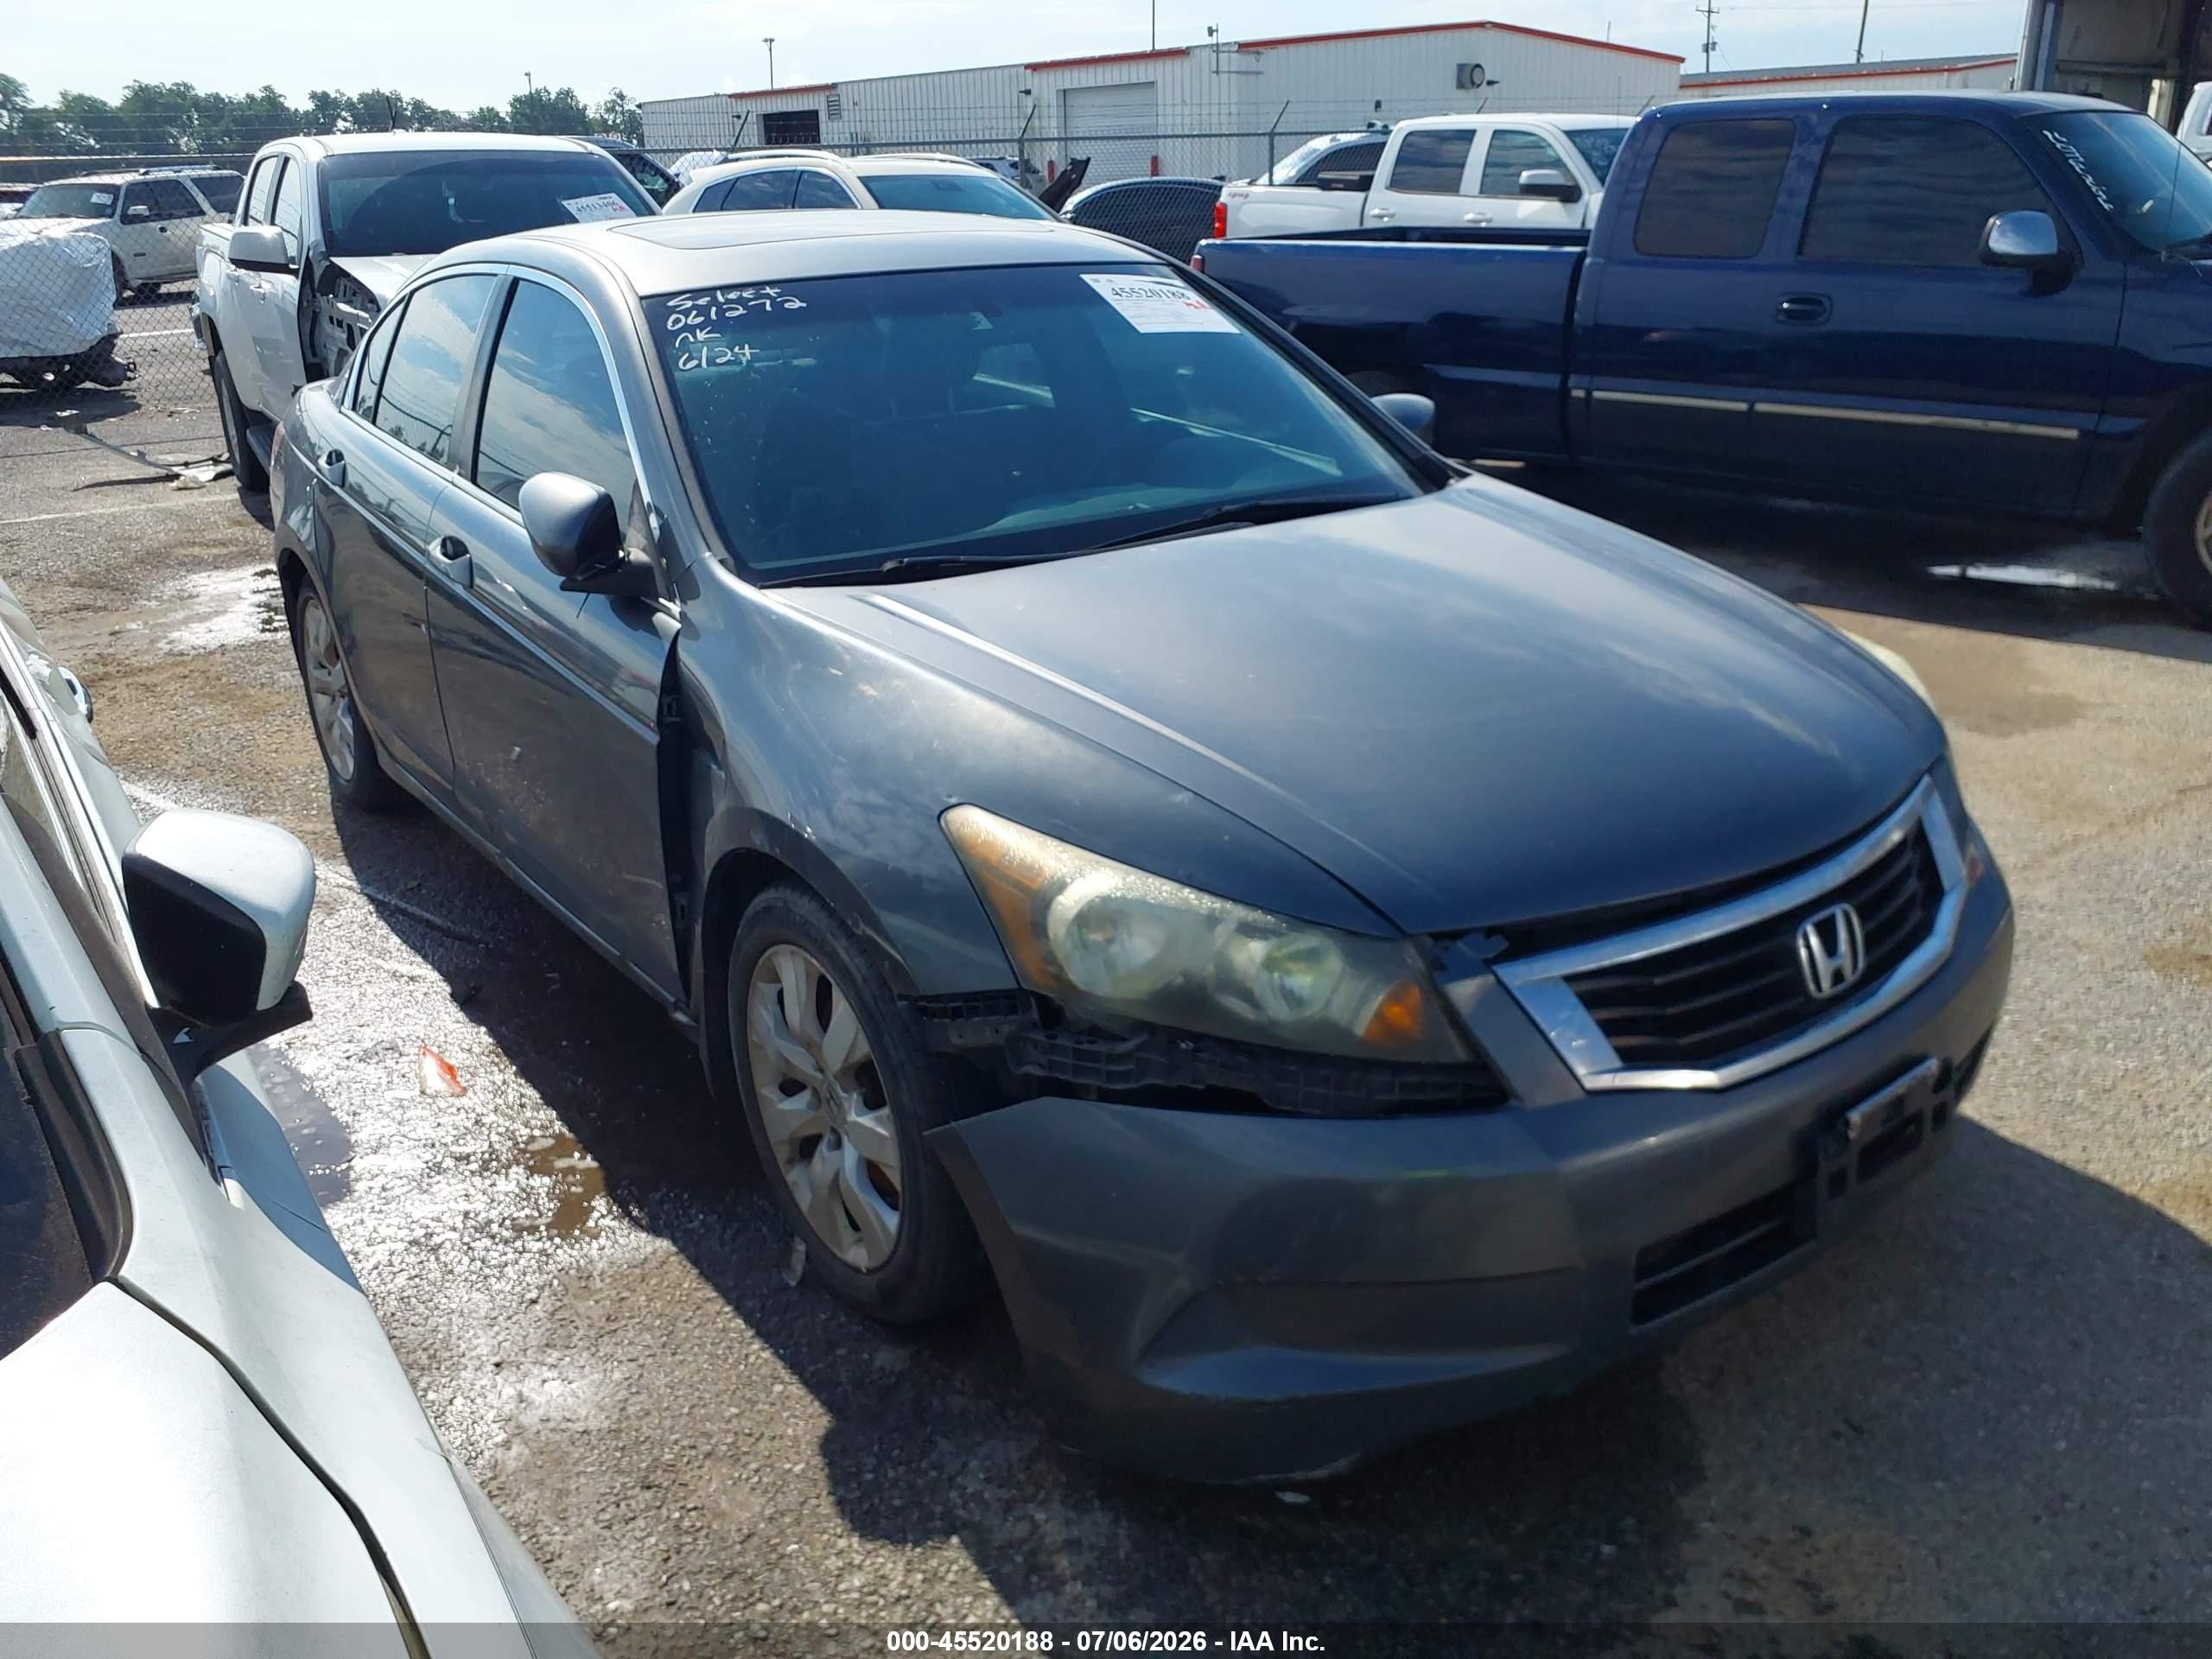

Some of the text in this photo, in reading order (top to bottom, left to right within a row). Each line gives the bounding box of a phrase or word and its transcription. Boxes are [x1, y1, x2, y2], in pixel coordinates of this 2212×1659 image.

[666, 285, 782, 311] Select
[1111, 286, 1191, 301] 45520188
[666, 296, 807, 331] 061272
